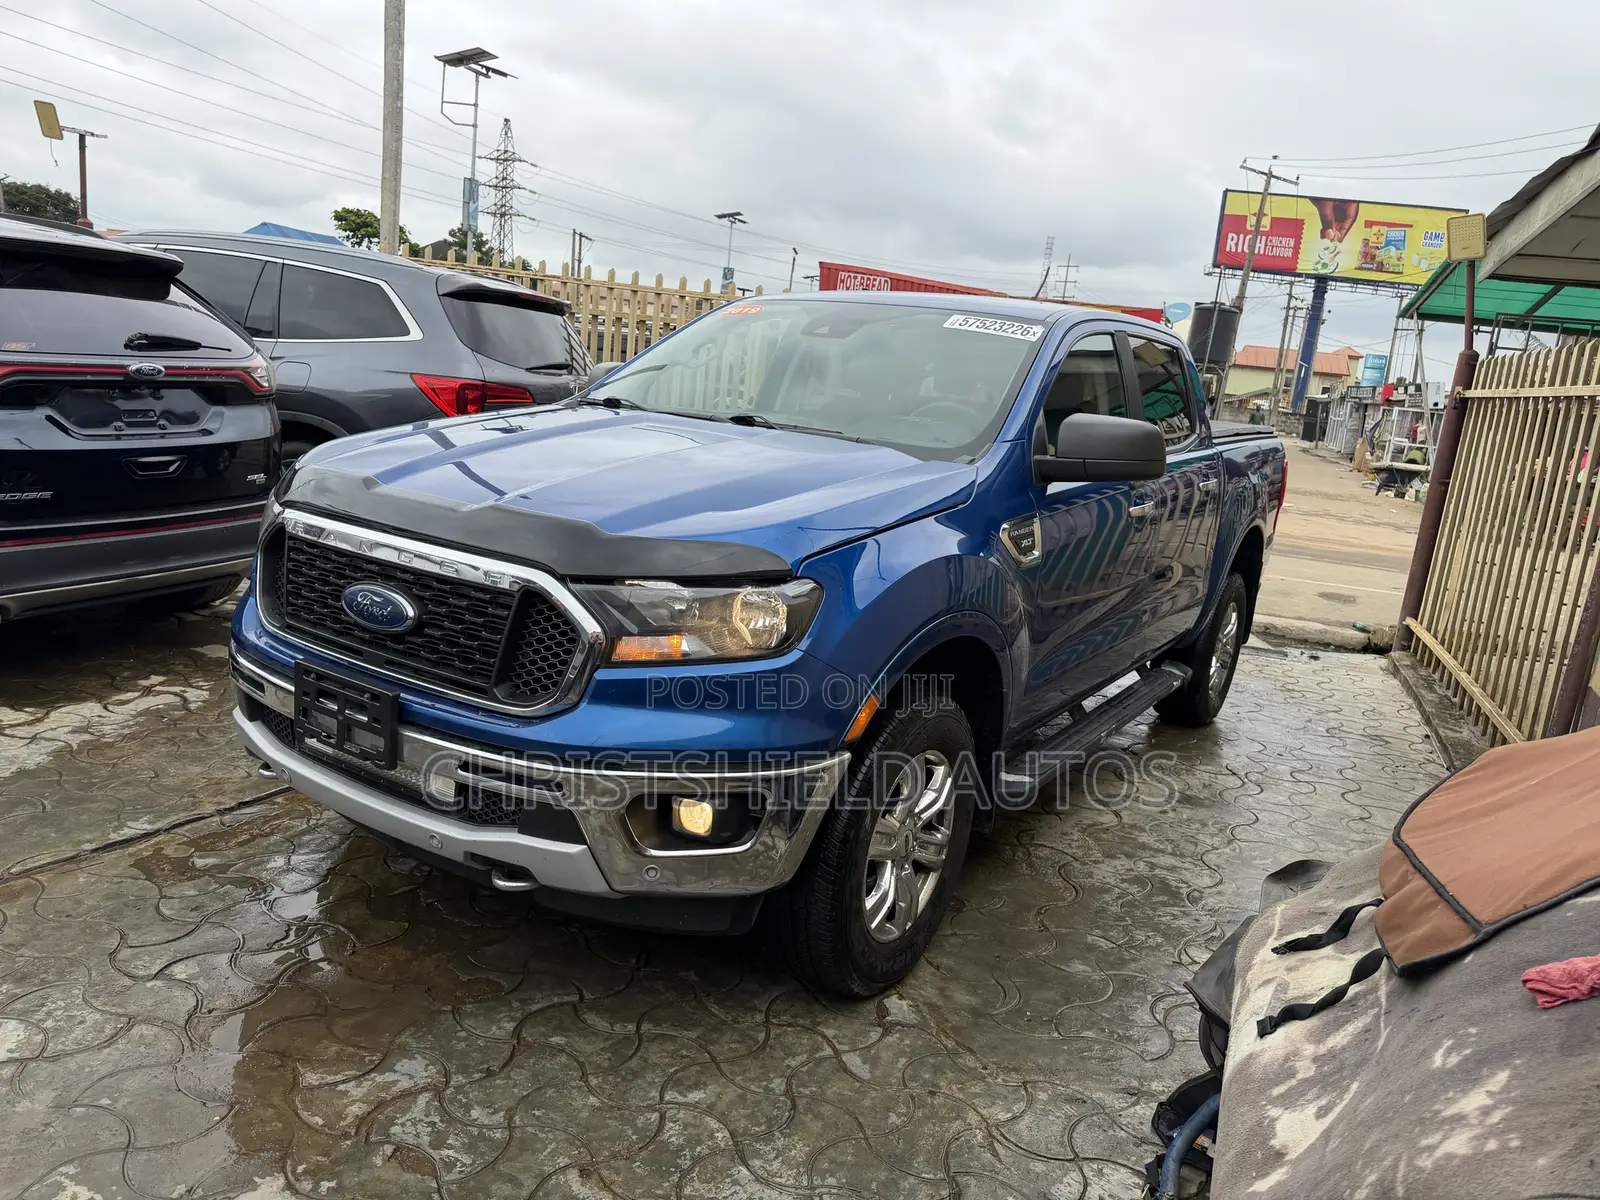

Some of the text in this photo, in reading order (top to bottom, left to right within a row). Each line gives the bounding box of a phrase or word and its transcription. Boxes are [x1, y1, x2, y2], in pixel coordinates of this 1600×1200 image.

[1225, 232, 1267, 255] RICH
[1266, 236, 1295, 248] CHICKEN
[1265, 246, 1293, 258] FLAVOUR
[837, 271, 891, 291] HOT BREAD
[1021, 537, 1033, 547] XLT
[289, 519, 505, 587] RANGER
